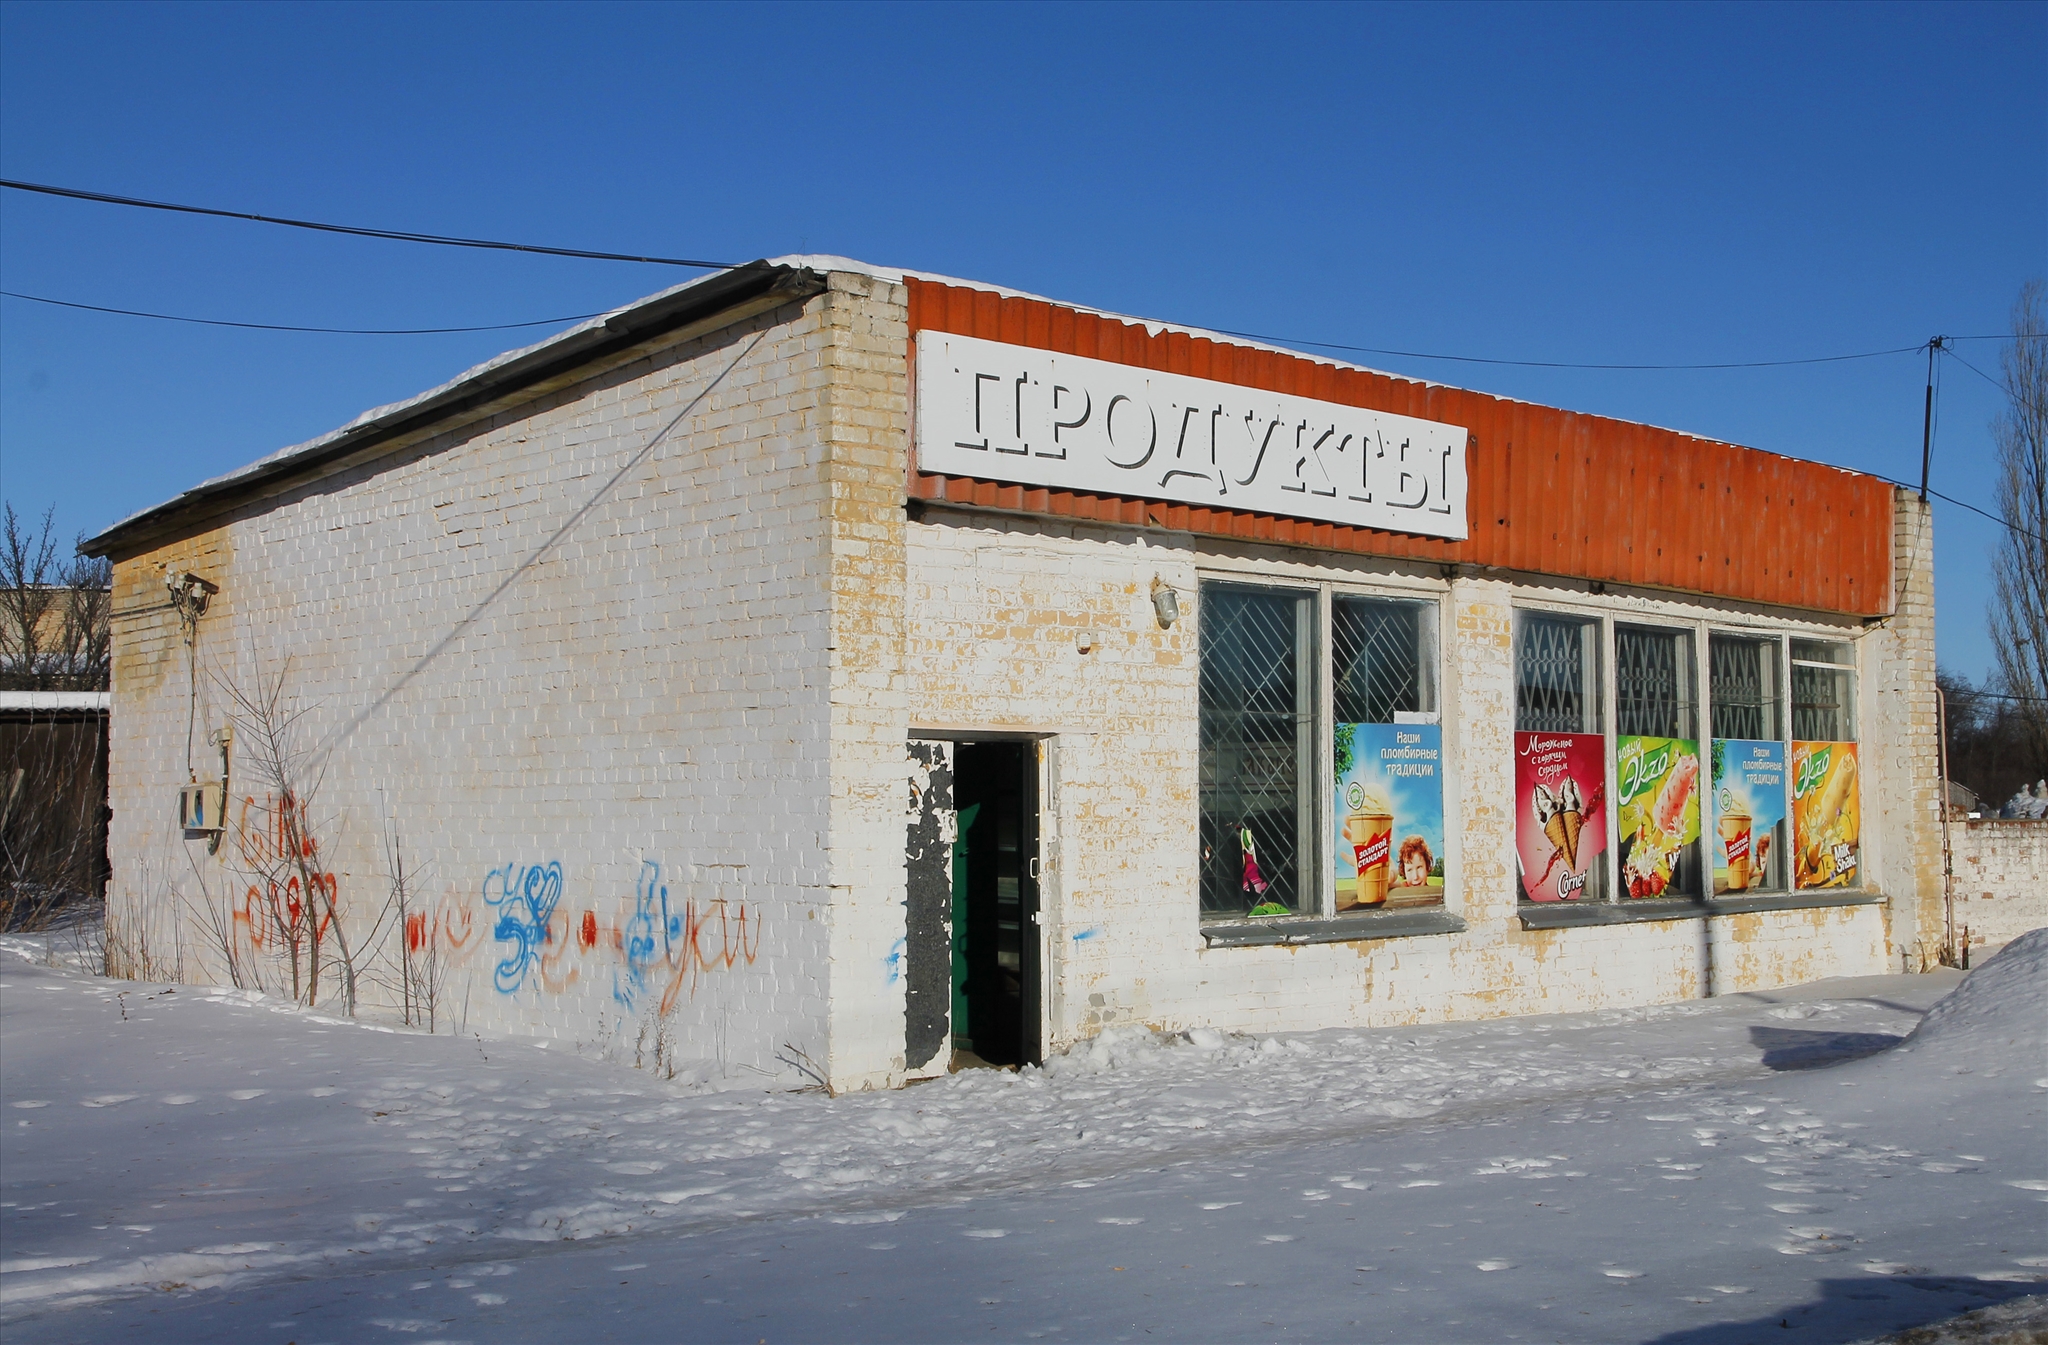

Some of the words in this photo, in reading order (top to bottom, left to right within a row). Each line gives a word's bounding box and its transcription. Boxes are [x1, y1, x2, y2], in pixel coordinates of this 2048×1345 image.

[953, 366, 1453, 515] ПРОДУКТЫ
[1396, 732, 1421, 744] Наши
[1519, 734, 1573, 756] Мороженое
[1381, 746, 1438, 760] пломбирные
[1537, 751, 1567, 765] горячим
[1753, 747, 1770, 757] Наши
[1386, 764, 1434, 778] традиции
[1746, 773, 1779, 785] традиции
[1359, 837, 1387, 860] ЗОЛОТОЙ
[1357, 846, 1389, 869] СТАНДАРТ
